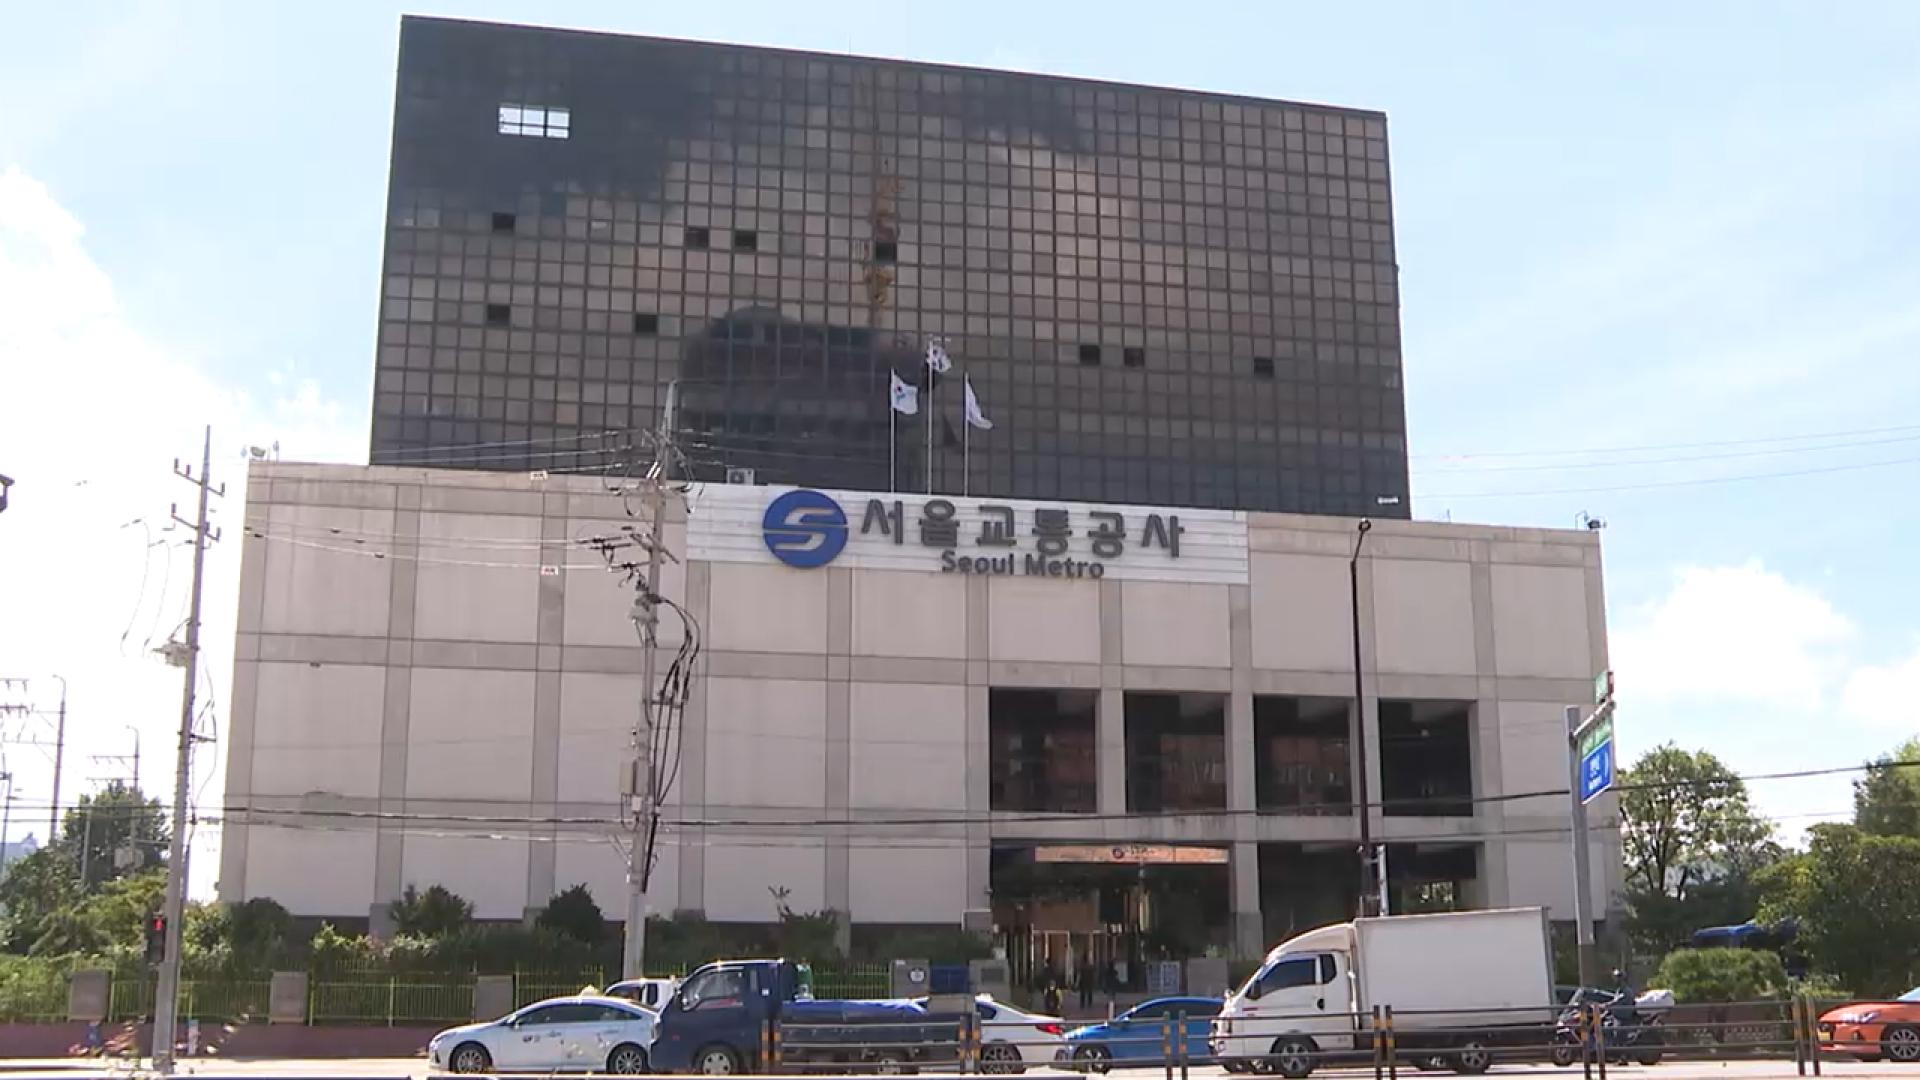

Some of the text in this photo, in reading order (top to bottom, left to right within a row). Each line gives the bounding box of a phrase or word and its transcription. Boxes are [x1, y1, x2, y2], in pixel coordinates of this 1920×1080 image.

[861, 499, 1185, 558] 서울교통공사
[941, 550, 1105, 579] Seoul Metro
